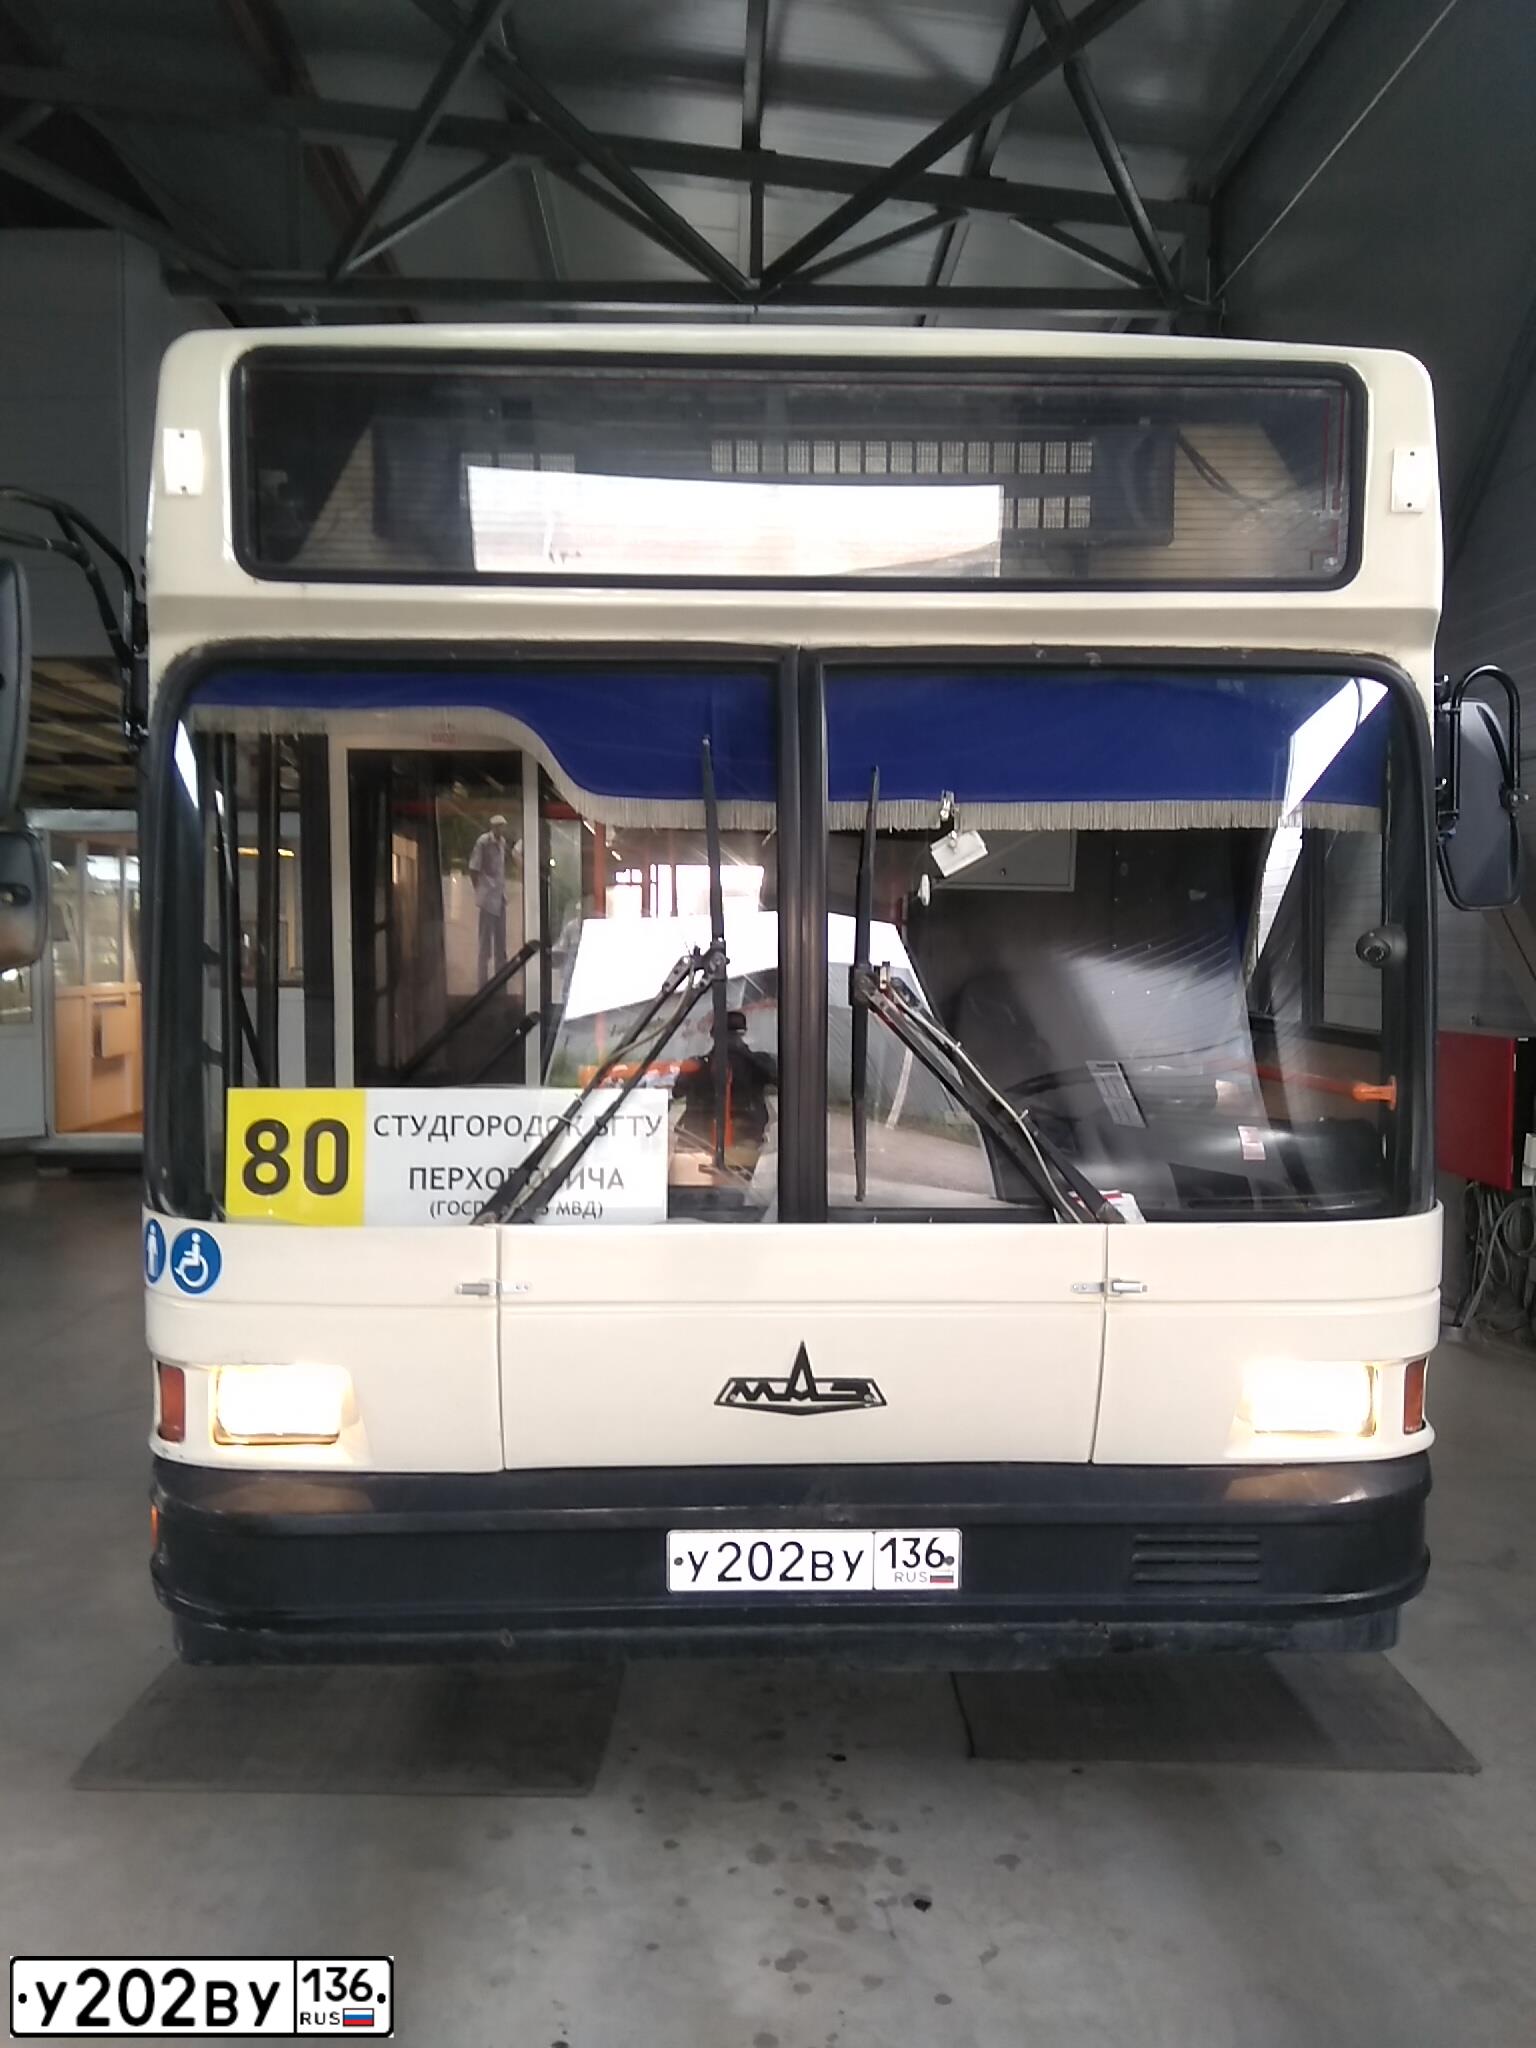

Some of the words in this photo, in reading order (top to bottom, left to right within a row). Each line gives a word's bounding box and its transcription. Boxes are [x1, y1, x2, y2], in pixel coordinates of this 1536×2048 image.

[241, 1117, 350, 1197] 80
[409, 1166, 624, 1191] ПЕРХОИЧА
[555, 1200, 603, 1219] МВД)
[880, 1536, 945, 1569] 136
[893, 1571, 928, 1584] RUS
